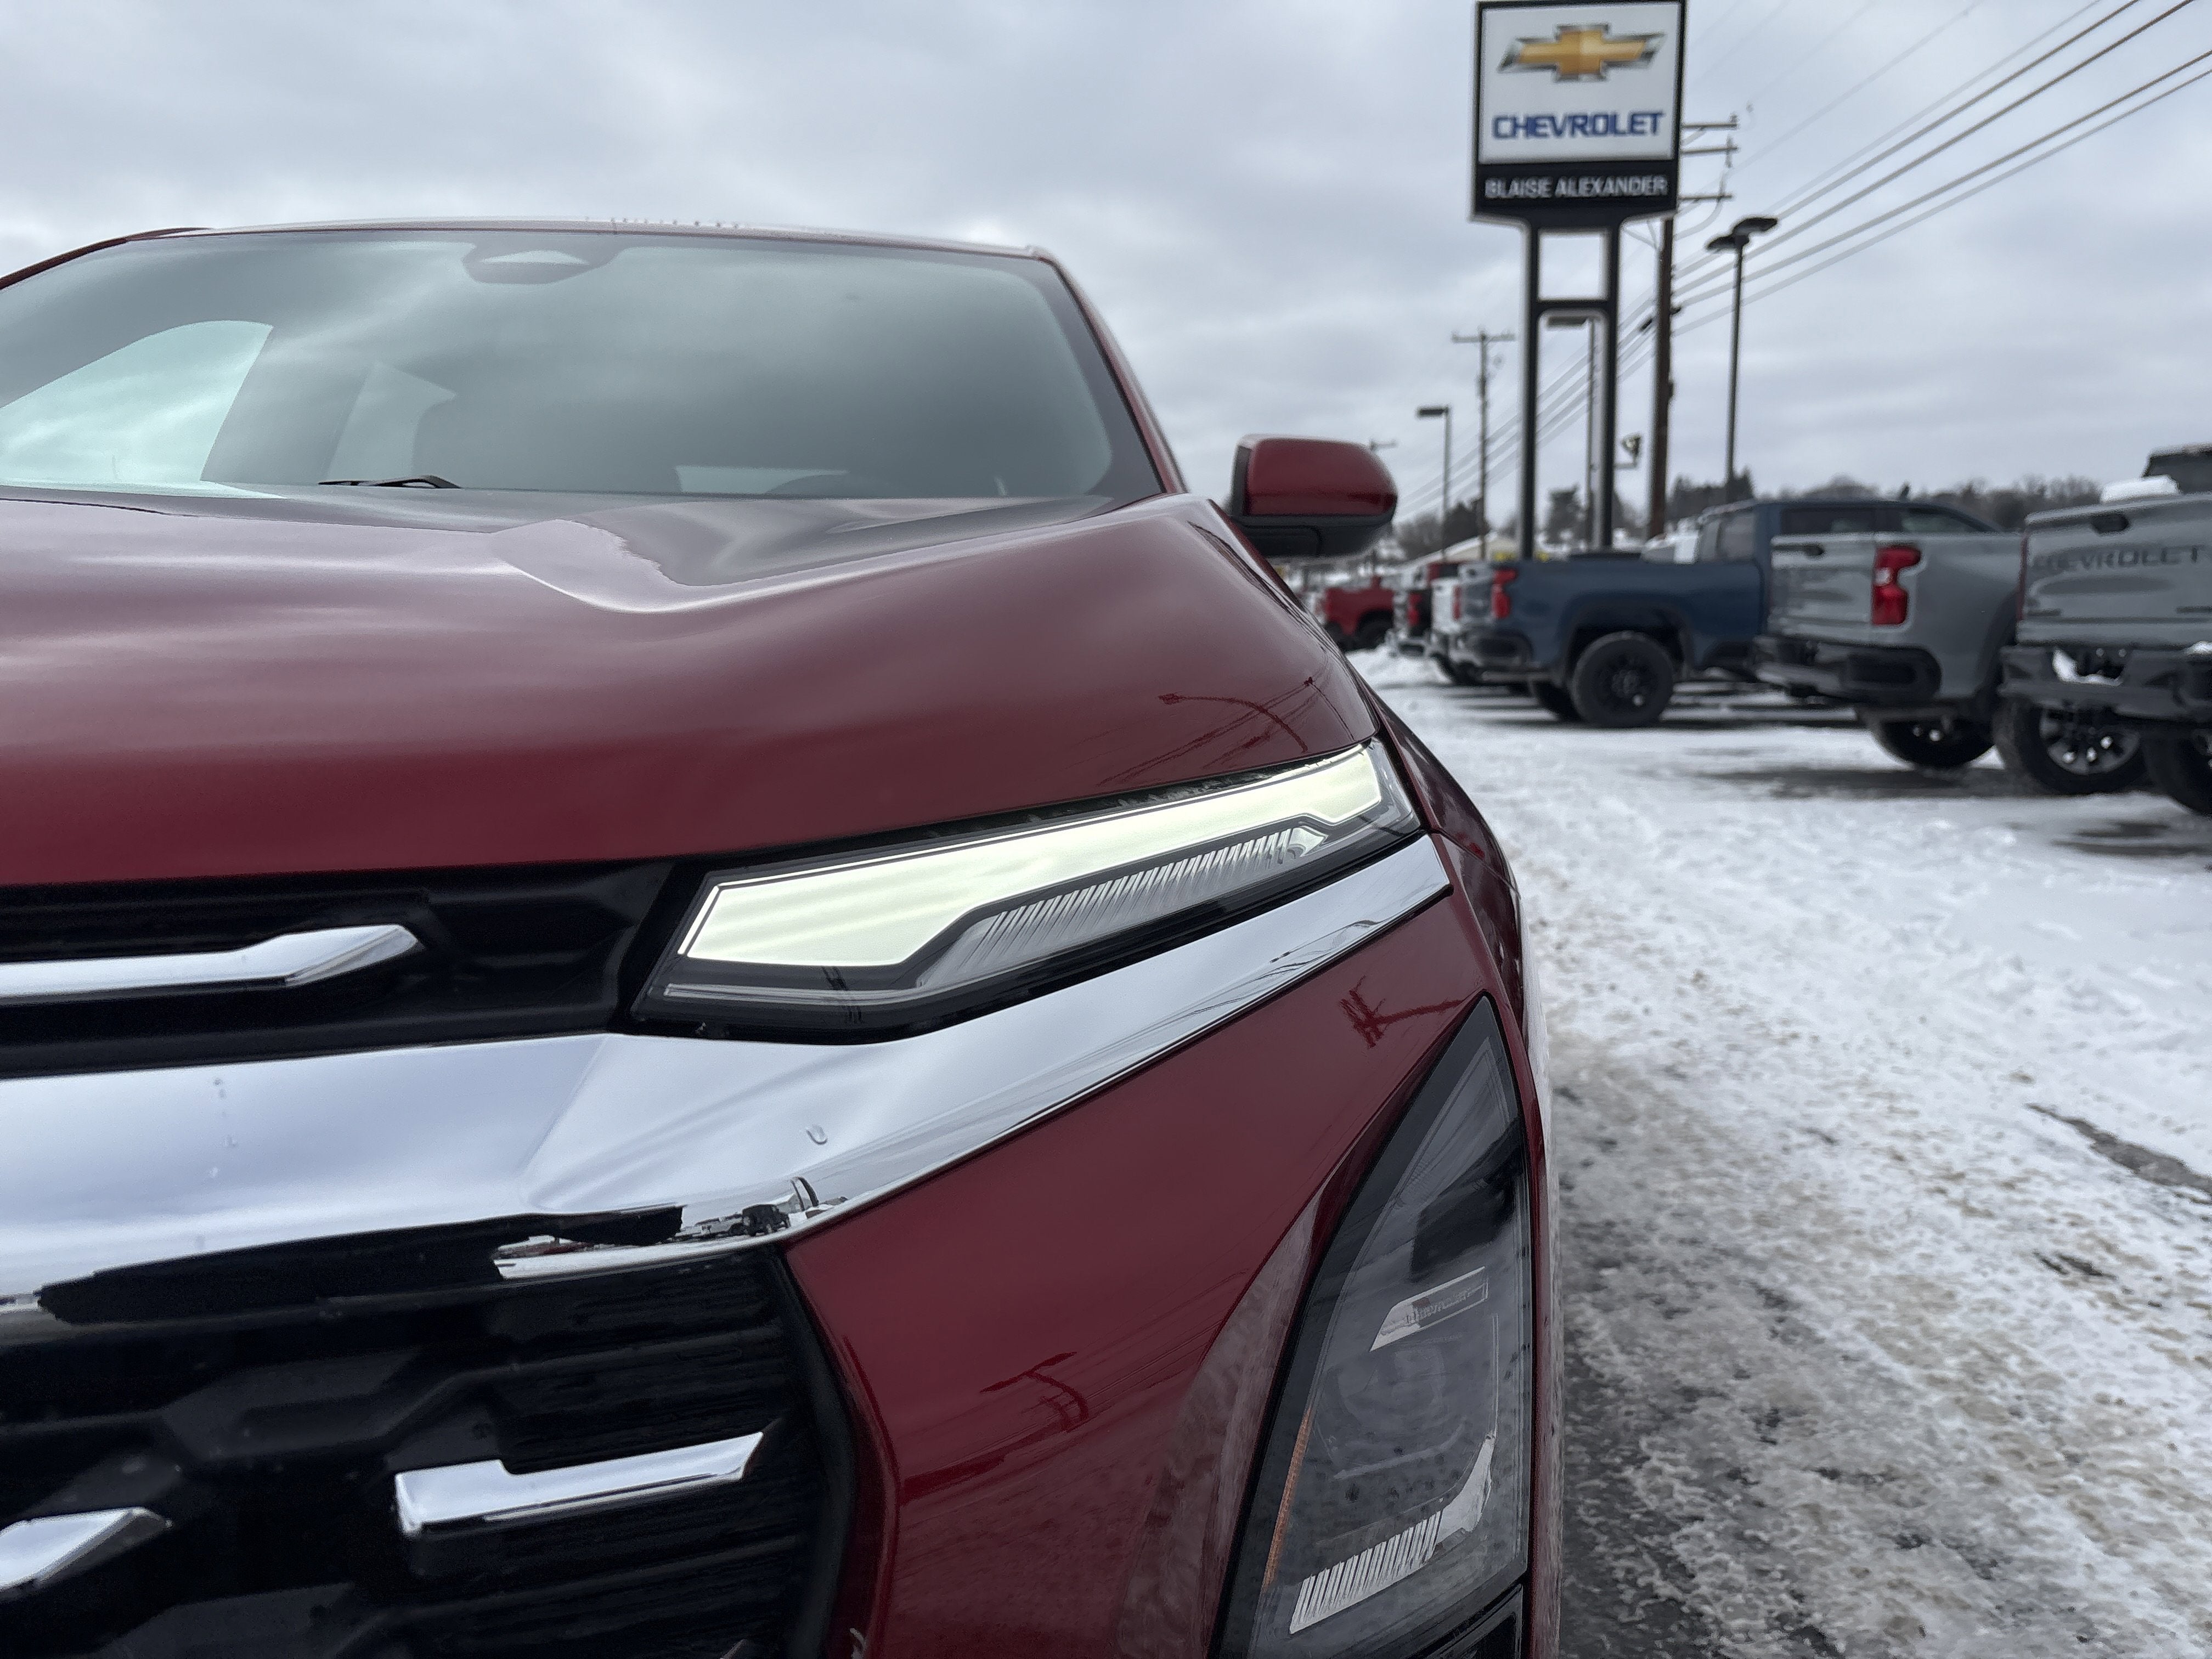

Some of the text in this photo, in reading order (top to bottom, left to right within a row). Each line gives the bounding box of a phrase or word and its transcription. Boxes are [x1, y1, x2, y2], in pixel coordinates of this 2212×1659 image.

[1492, 111, 1664, 139] CHEVROLET
[1485, 174, 1668, 198] BLAISE ALEXANDER
